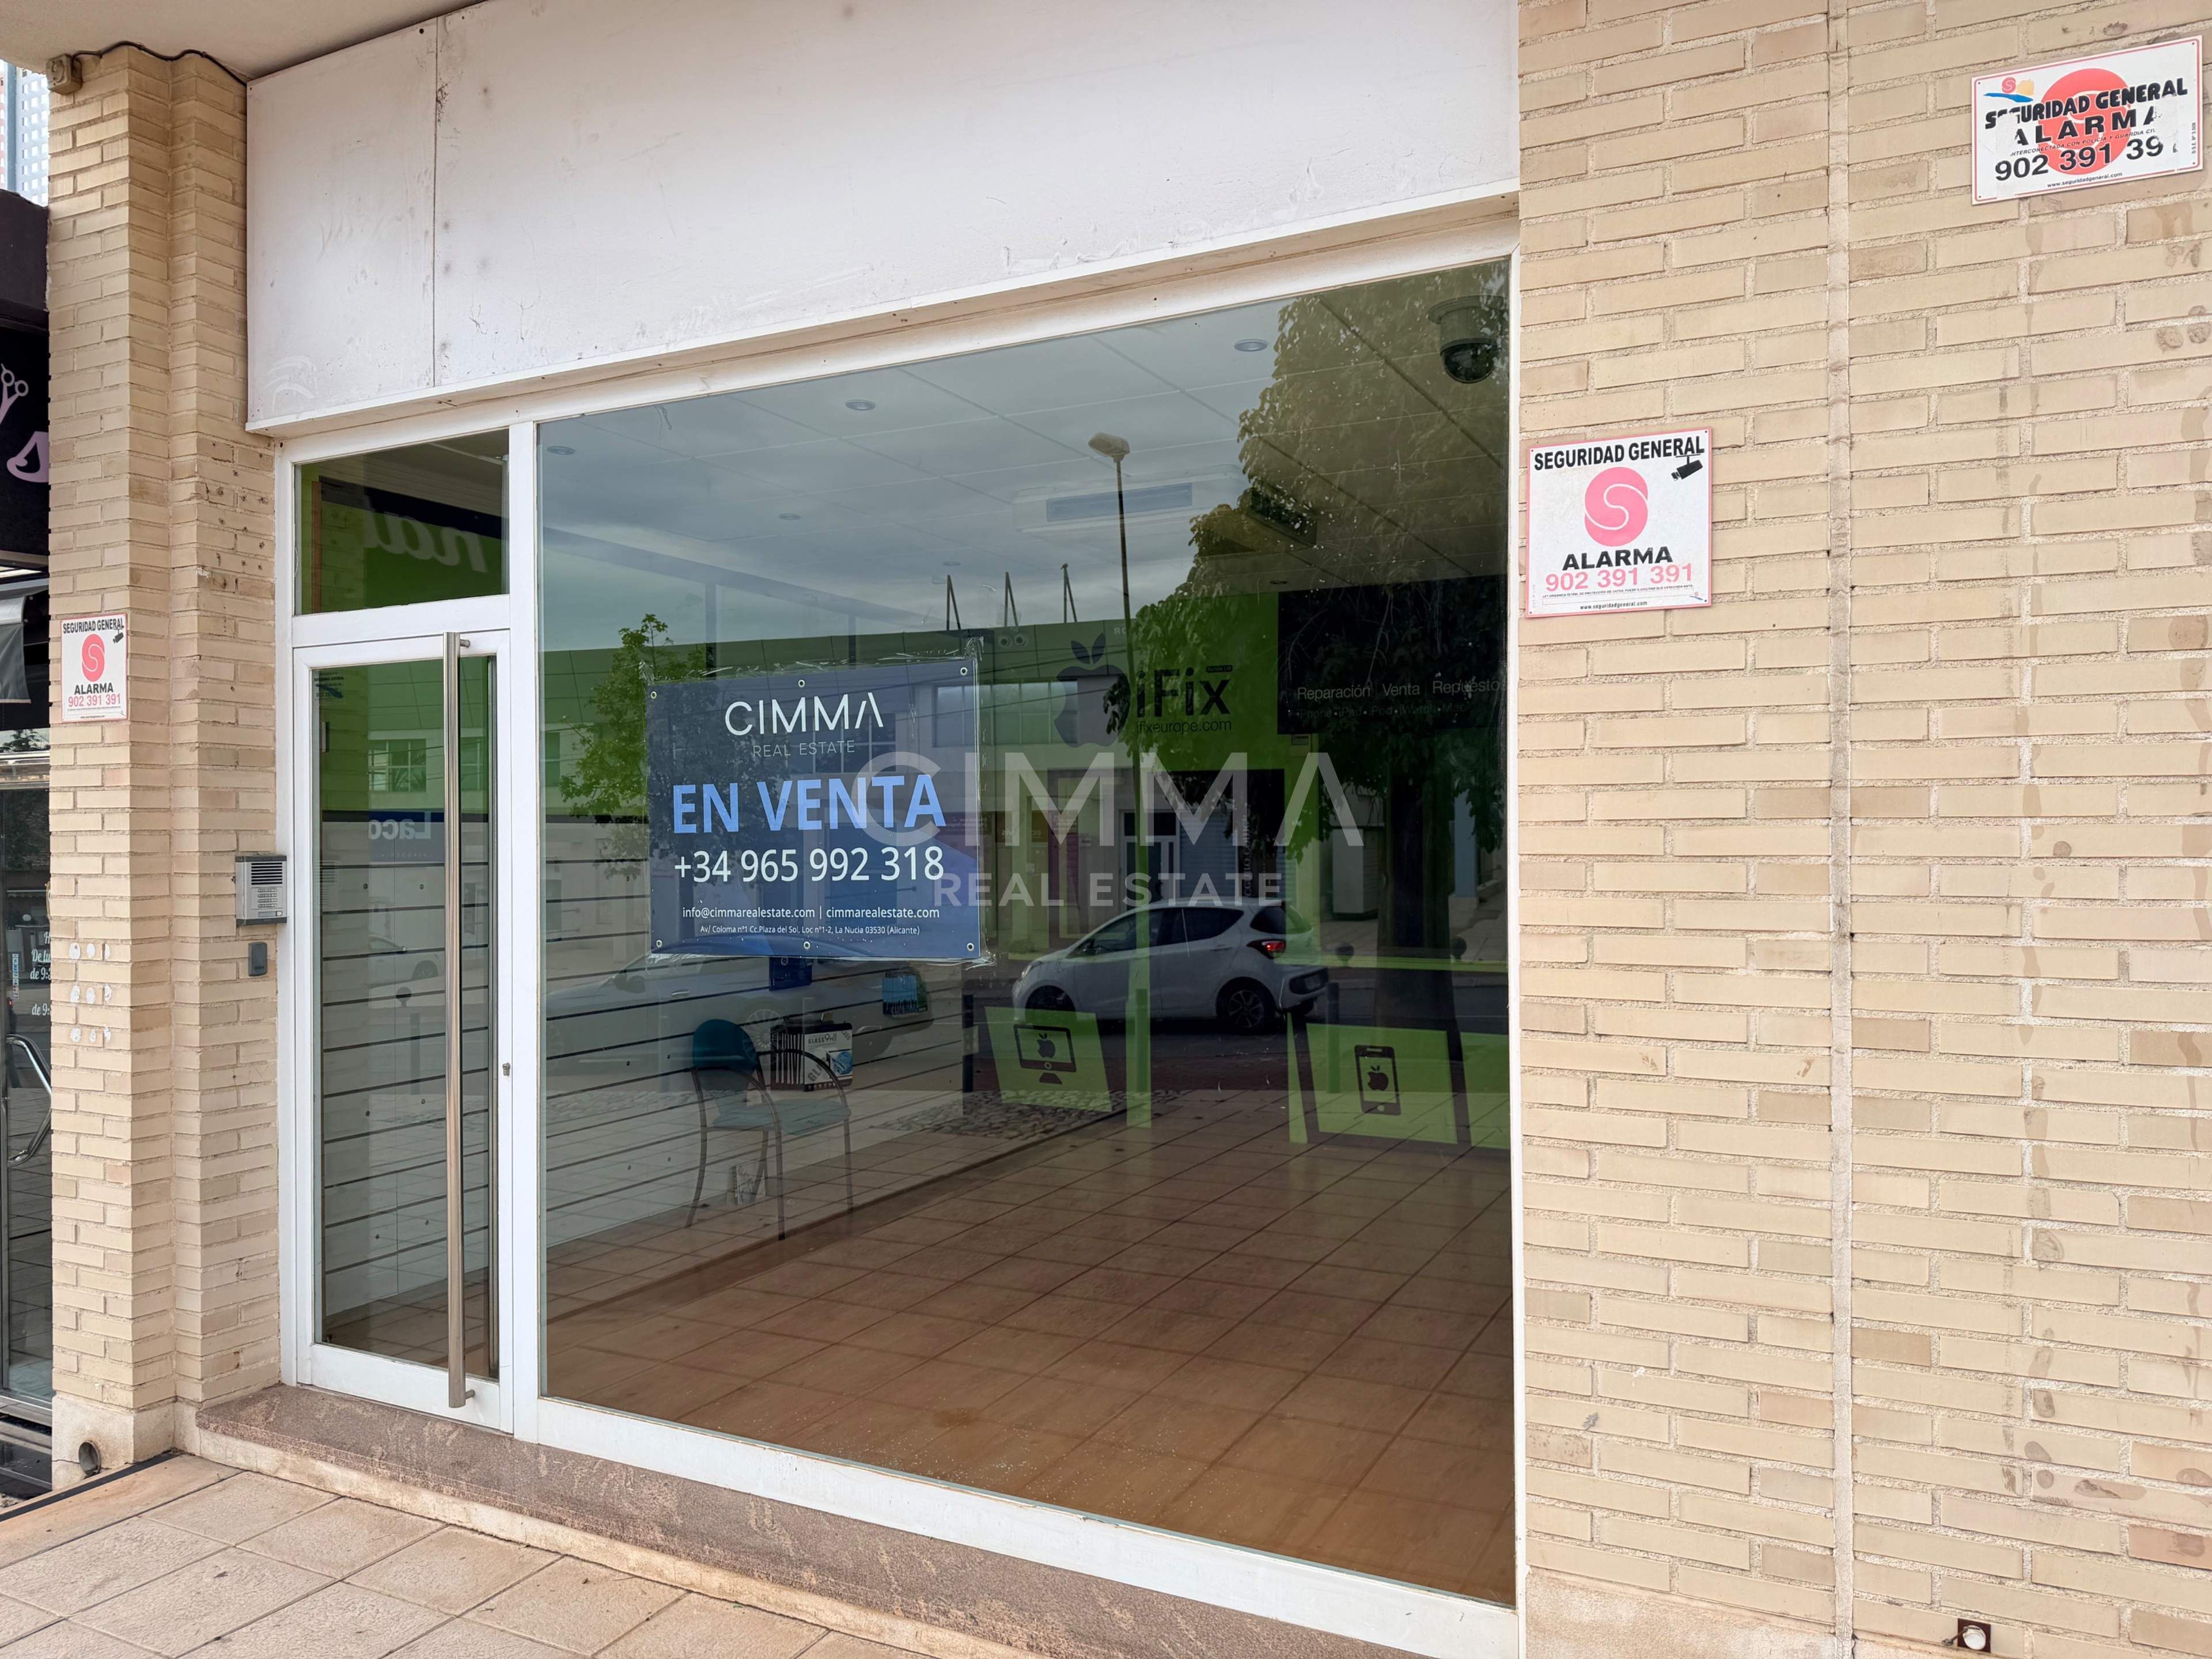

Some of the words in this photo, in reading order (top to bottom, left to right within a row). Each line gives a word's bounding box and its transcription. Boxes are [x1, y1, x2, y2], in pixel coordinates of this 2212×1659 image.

[1984, 95, 2090, 130] SURIDAD
[2095, 78, 2188, 109] GENERAL
[2115, 130, 2143, 139] GUARDIA
[1995, 154, 2049, 181] 902
[2060, 143, 2111, 171] 391
[2047, 172, 2123, 188] www.seguridadgeneral.com
[1534, 444, 1624, 471] SEGURIDAD
[1628, 435, 1705, 461] GENERAL
[1562, 546, 1673, 570] ALARMA
[1545, 571, 1589, 592] 902
[1597, 567, 1638, 588] 391
[1650, 563, 1692, 584] 391
[1580, 601, 1647, 609] www.seguridadgeneral.com
[63, 620, 96, 634] SEGURIDAD
[97, 618, 124, 631] GENERAL
[74, 683, 113, 695] ALARMA
[1137, 668, 1230, 718] iFix
[1297, 684, 1370, 702] Reparación
[1382, 683, 1421, 696] Venta
[68, 696, 84, 707] 902
[86, 695, 102, 706] 391
[106, 694, 120, 704] 391
[725, 692, 884, 736] CIMMA
[1137, 720, 1232, 734] ifixeurope.com
[752, 743, 791, 758] REAL
[799, 740, 855, 755] ESTATE
[673, 782, 740, 834] EN
[756, 774, 946, 831] VENTA
[674, 850, 731, 882] +34
[741, 849, 798, 882] 965
[810, 847, 870, 881] 992
[881, 846, 945, 880] 318
[683, 907, 815, 919] info@cimmarealestate.com
[826, 907, 940, 918] cimmarealestate.com
[700, 925, 711, 934] Av/
[789, 926, 800, 934] Sol,
[887, 926, 921, 935] (Alicante)
[31, 949, 42, 962] De
[30, 968, 40, 980] de
[32, 1003, 41, 1016] de
